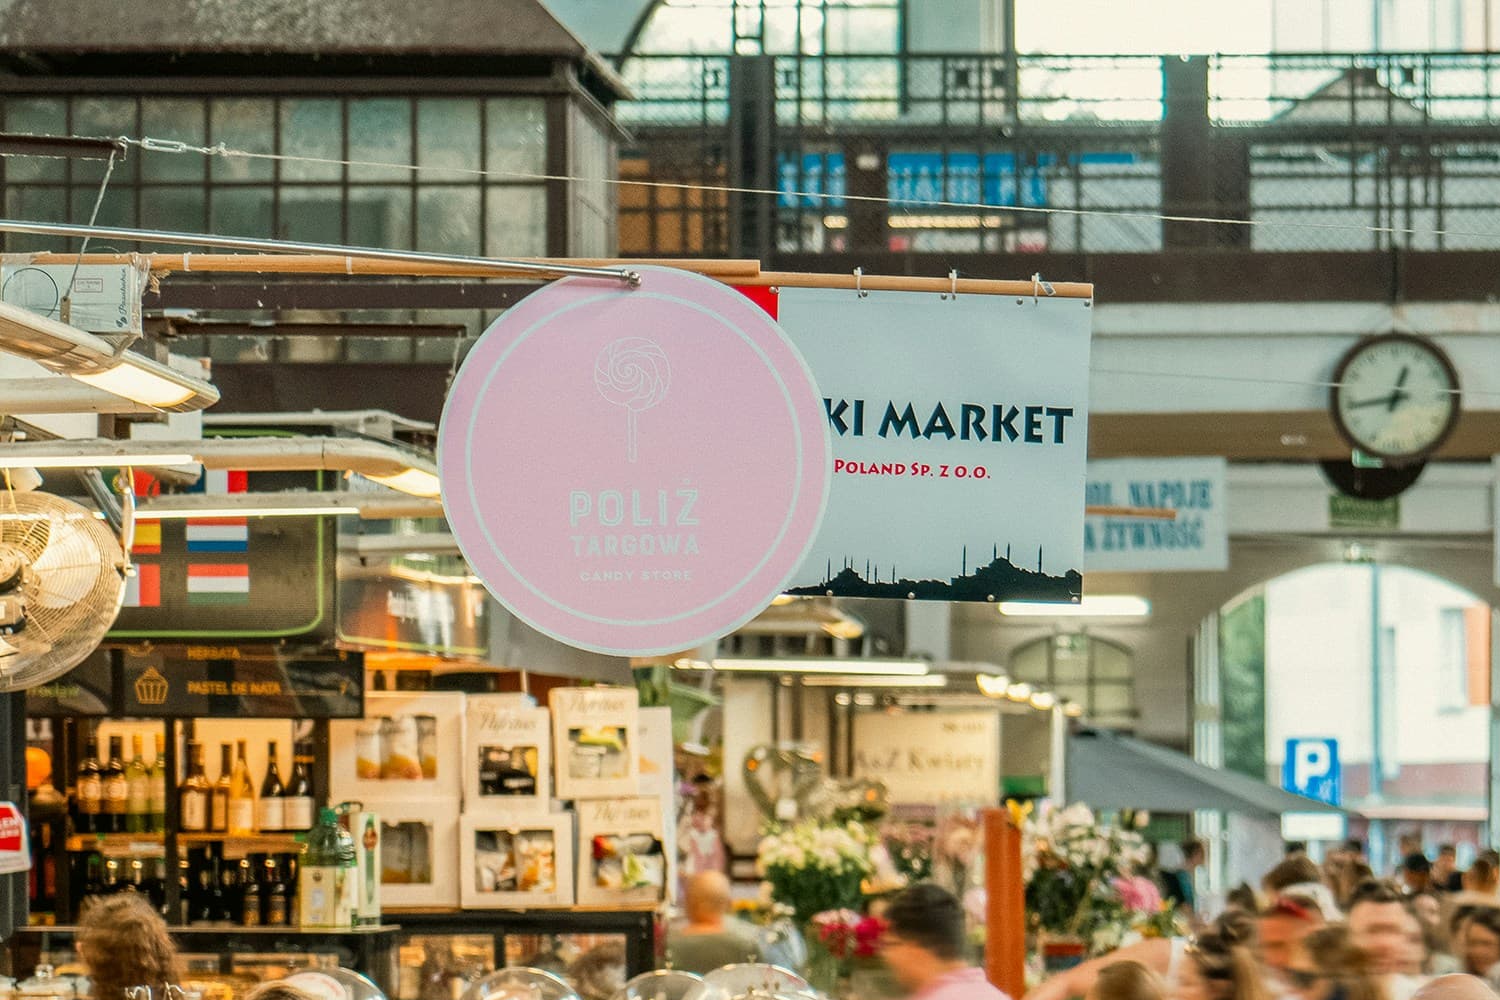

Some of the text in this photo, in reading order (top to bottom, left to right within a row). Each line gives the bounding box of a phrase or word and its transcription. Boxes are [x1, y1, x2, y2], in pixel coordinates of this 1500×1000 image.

[823, 398, 1074, 444] KI MARKET
[834, 459, 906, 476] POLAND
[954, 466, 991, 479] O.O.
[570, 534, 699, 556] TARGOWA
[579, 570, 694, 583] CANDY STORE
[1295, 741, 1330, 791] P
